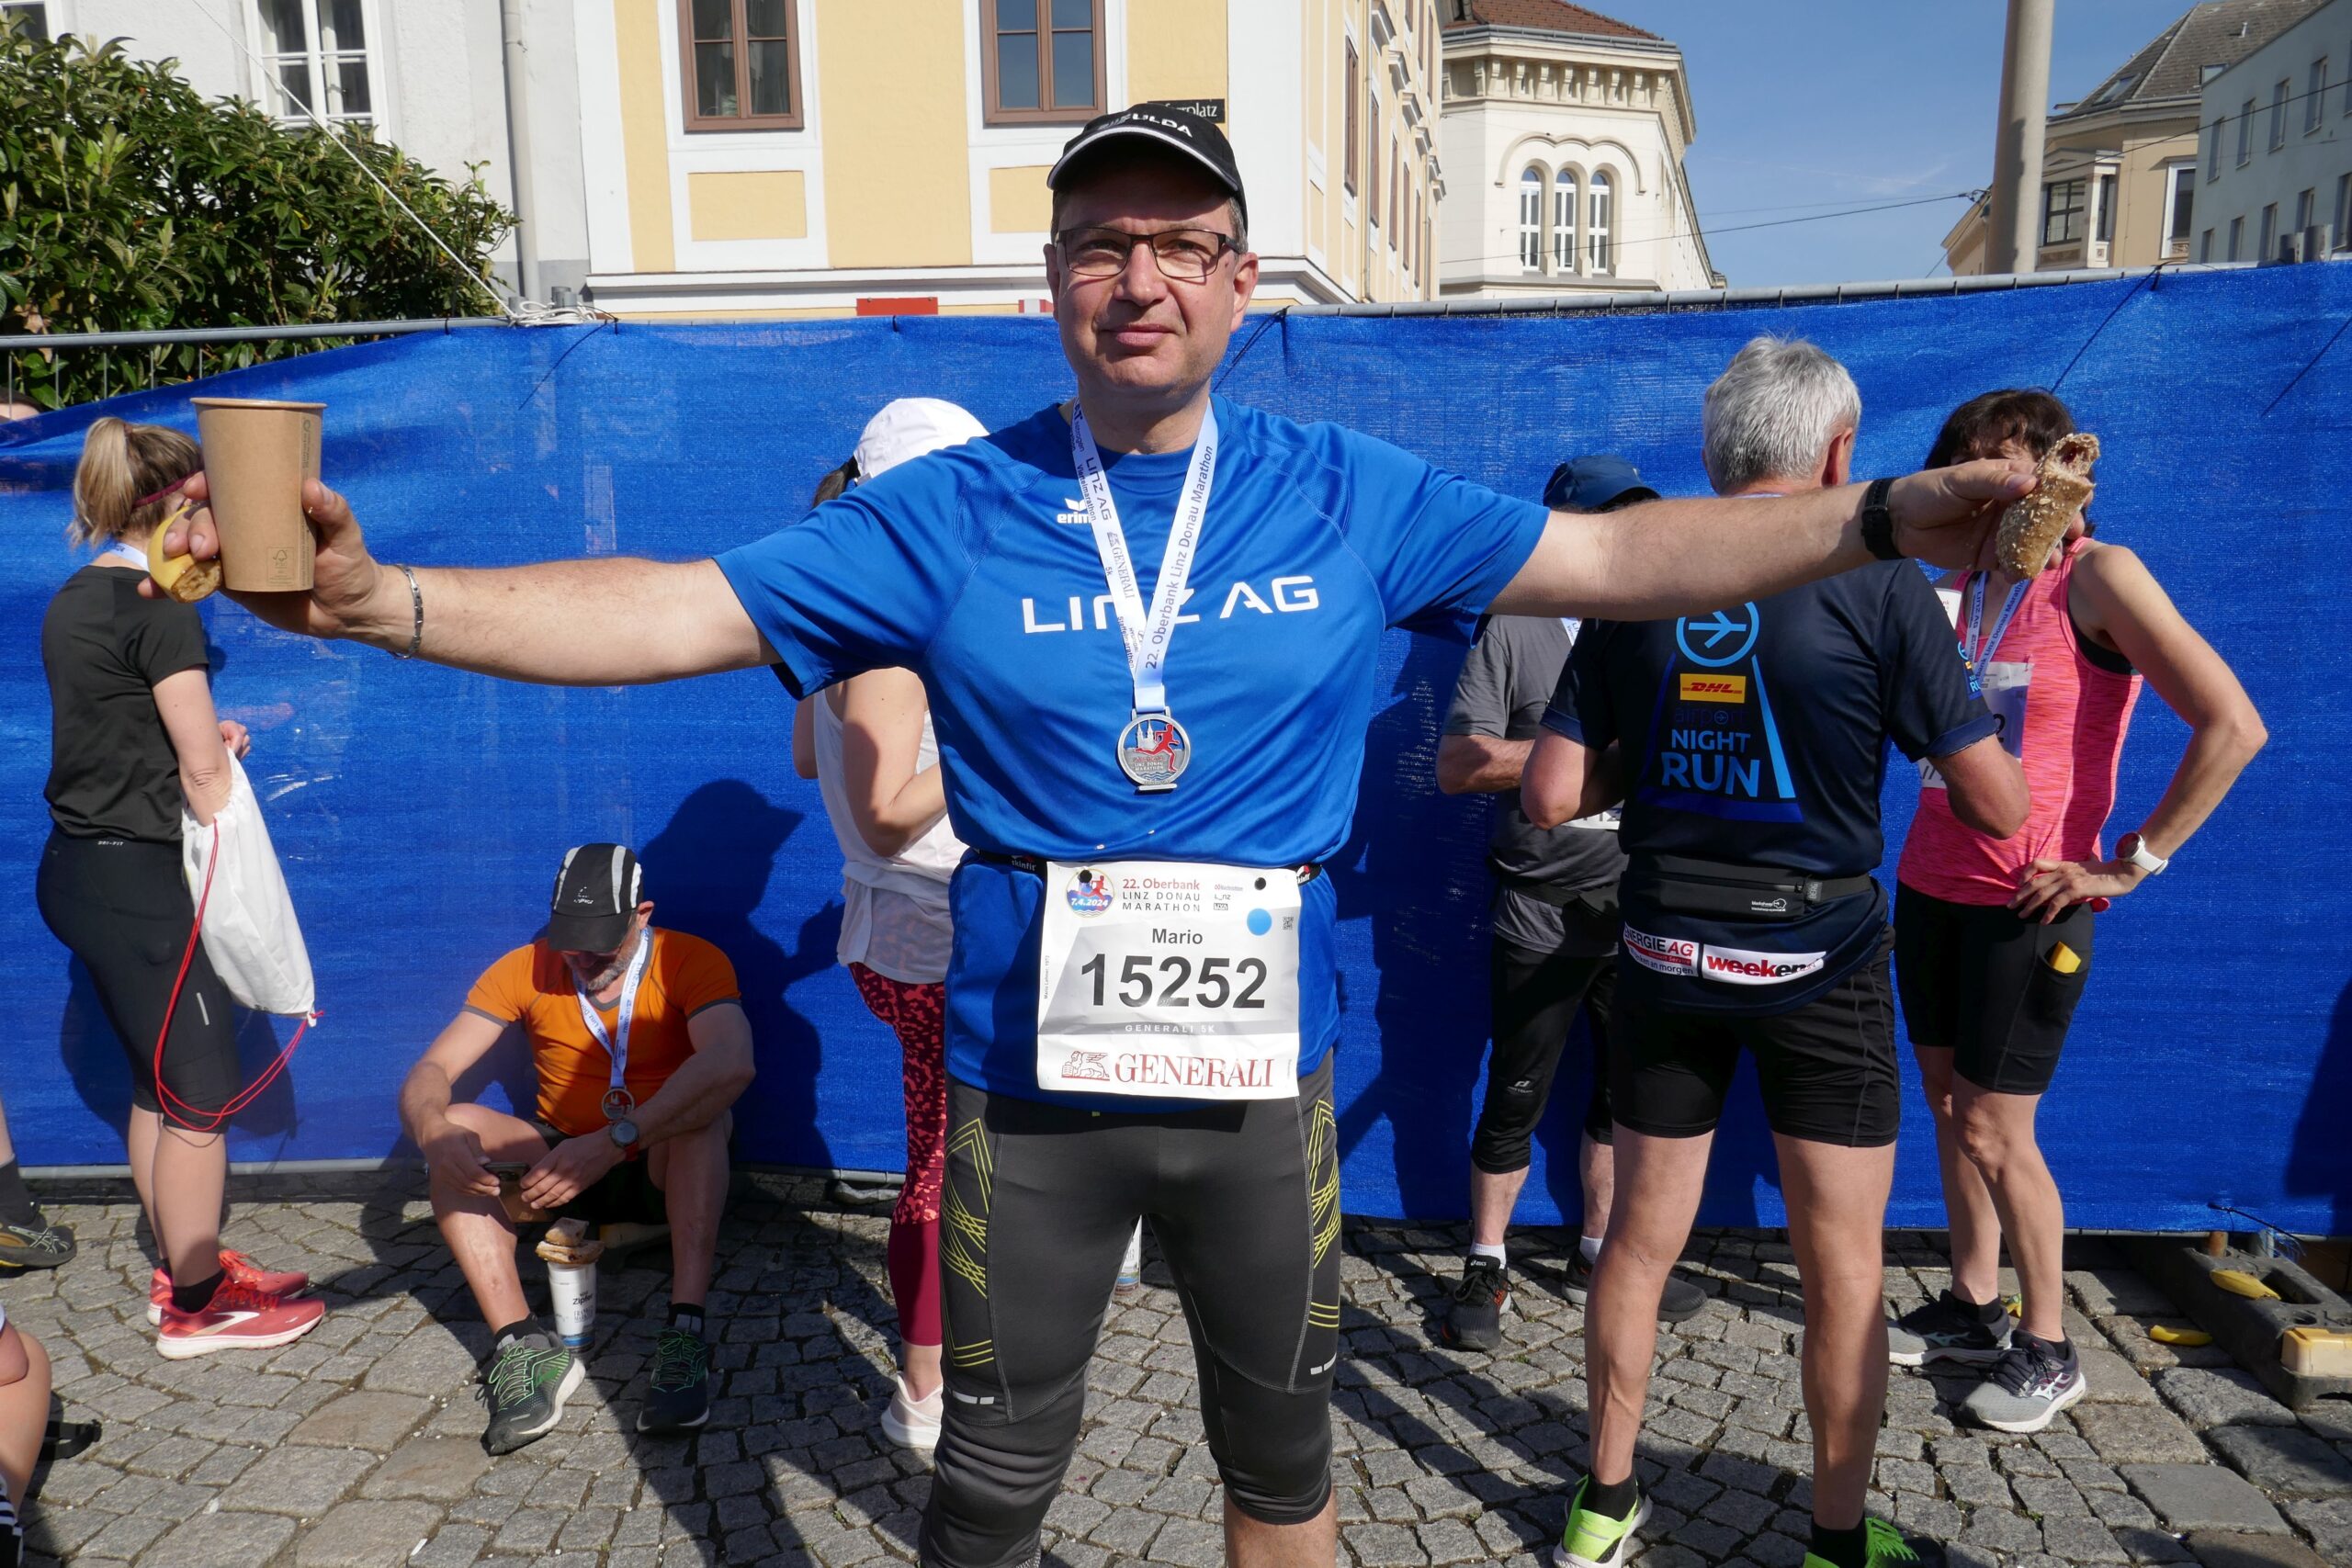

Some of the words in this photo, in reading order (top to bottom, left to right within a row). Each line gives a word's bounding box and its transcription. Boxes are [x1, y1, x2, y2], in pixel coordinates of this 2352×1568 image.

[1191, 446, 1213, 504] Marathon
[1077, 464, 1097, 521] Viertelmarathon
[1097, 496, 1112, 521] AG
[1179, 506, 1199, 549] Donau
[1113, 547, 1136, 599] GENERALI
[1170, 551, 1187, 578] Linz
[1219, 575, 1319, 619] AG
[1993, 614, 2009, 639] Donau
[2006, 579, 2026, 613] Maratho
[1151, 581, 1180, 645] Oberbank
[1117, 616, 1135, 669] Staffelmarathon
[1145, 649, 1161, 670] 22.
[1690, 682, 1735, 694] DHL
[1671, 728, 1751, 753] NIGHT
[1661, 751, 1760, 798] RUN
[1012, 860, 1037, 872] skinfit
[1123, 878, 1140, 889] 22.
[1142, 878, 1201, 890] Oberbank
[1123, 891, 1149, 900] LINZ
[1157, 891, 1201, 902] DONAU
[1070, 897, 1109, 908] 7.4.2024
[1122, 902, 1201, 912] MARATHON
[1151, 928, 1204, 945] Mario
[1667, 942, 1693, 957] AG
[1658, 964, 1694, 976] morgen
[1706, 955, 1807, 978] weeken
[1081, 953, 1268, 1009] 15252
[1125, 1024, 1194, 1034] GENERALI
[1200, 1024, 1216, 1034] 5K
[1114, 1053, 1275, 1088] GENERALI
[572, 1293, 594, 1305] Zipfer
